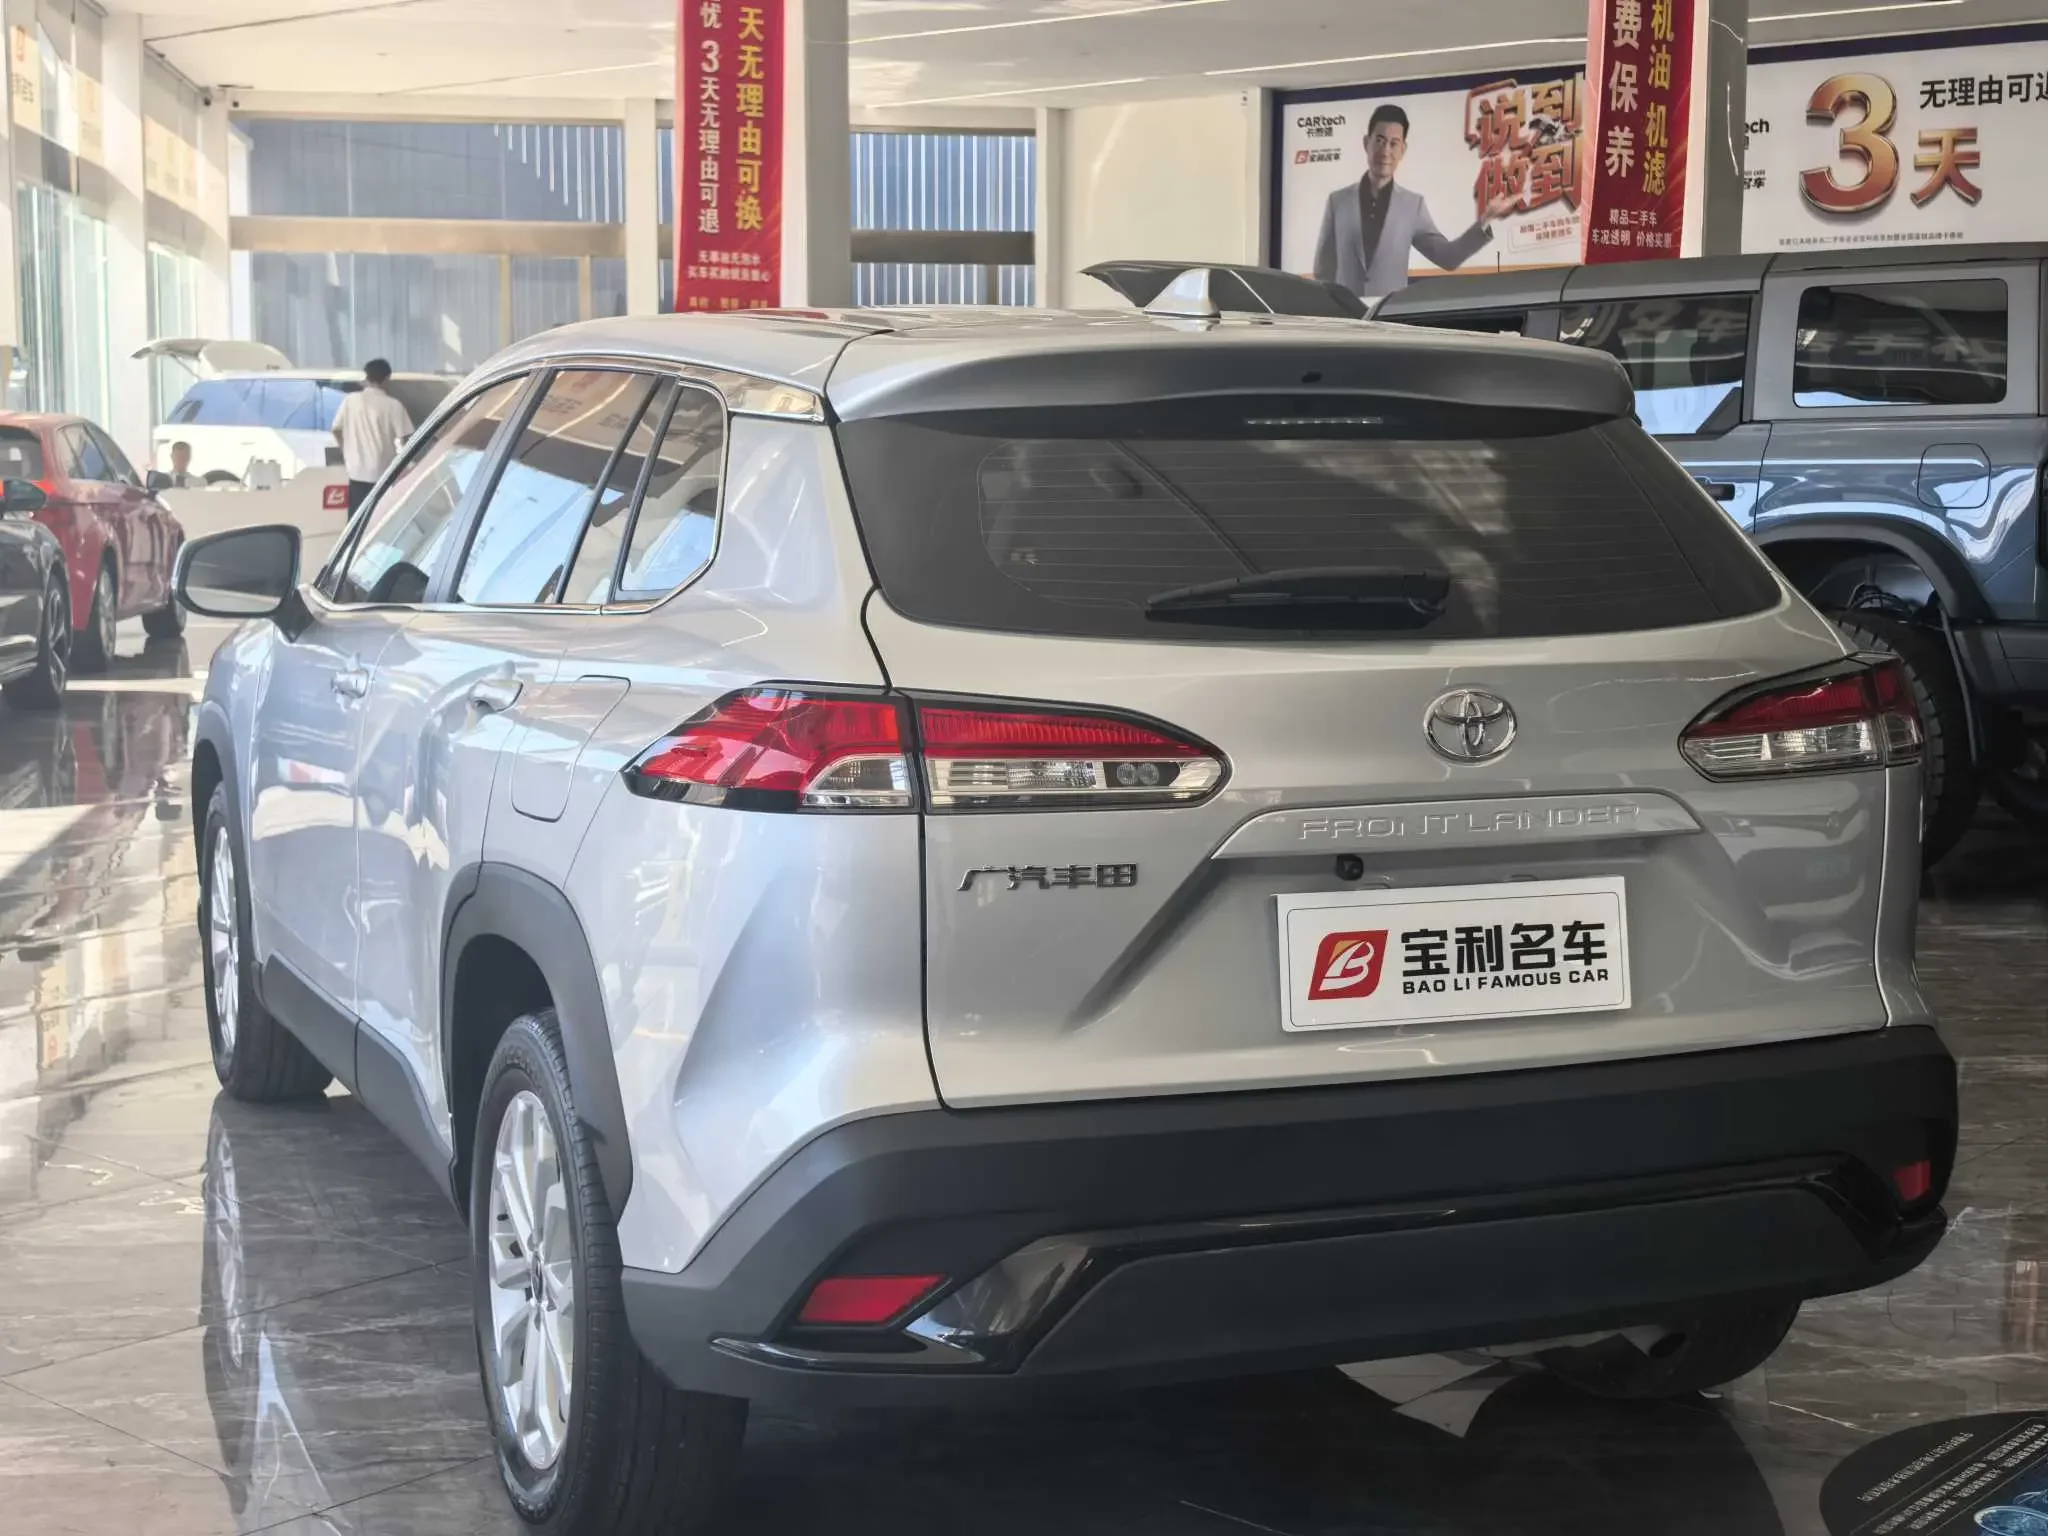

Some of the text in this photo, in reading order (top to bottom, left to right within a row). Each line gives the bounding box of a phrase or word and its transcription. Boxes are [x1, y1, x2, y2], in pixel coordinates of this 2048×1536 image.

[1605, 0, 1642, 178] 费保养
[736, 7, 764, 230] 天无理由可换
[1591, 228, 1631, 247] 车况透明
[956, 862, 1139, 892] 广汽丰田
[1400, 920, 1608, 977] 宝利名车
[1402, 968, 1609, 995] BAO LI FAMOUS CAR
